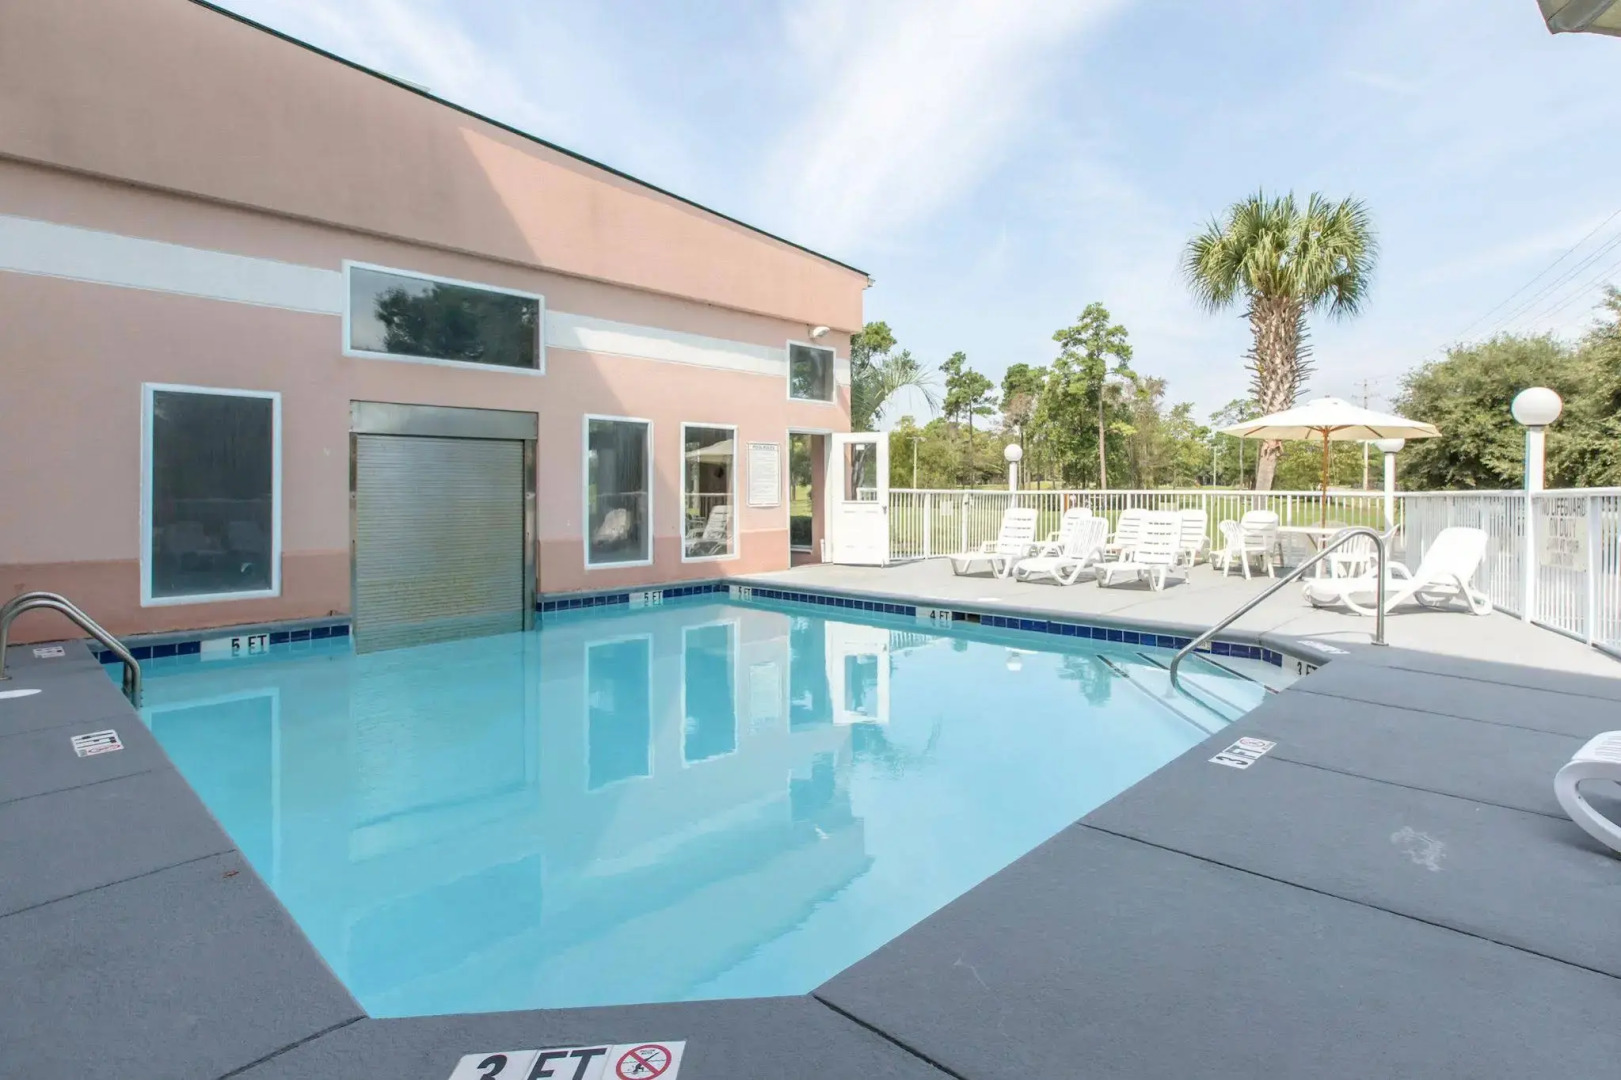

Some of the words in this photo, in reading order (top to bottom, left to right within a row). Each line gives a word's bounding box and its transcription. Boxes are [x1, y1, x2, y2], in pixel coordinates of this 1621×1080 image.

[652, 590, 662, 599] FT
[929, 610, 936, 619] 4
[939, 611, 950, 620] FT
[231, 638, 240, 648] 5
[248, 634, 267, 647] FT
[1297, 661, 1302, 676] 3
[1224, 745, 1263, 759] FT
[1215, 756, 1249, 766] 3
[526, 1048, 608, 1080] FT
